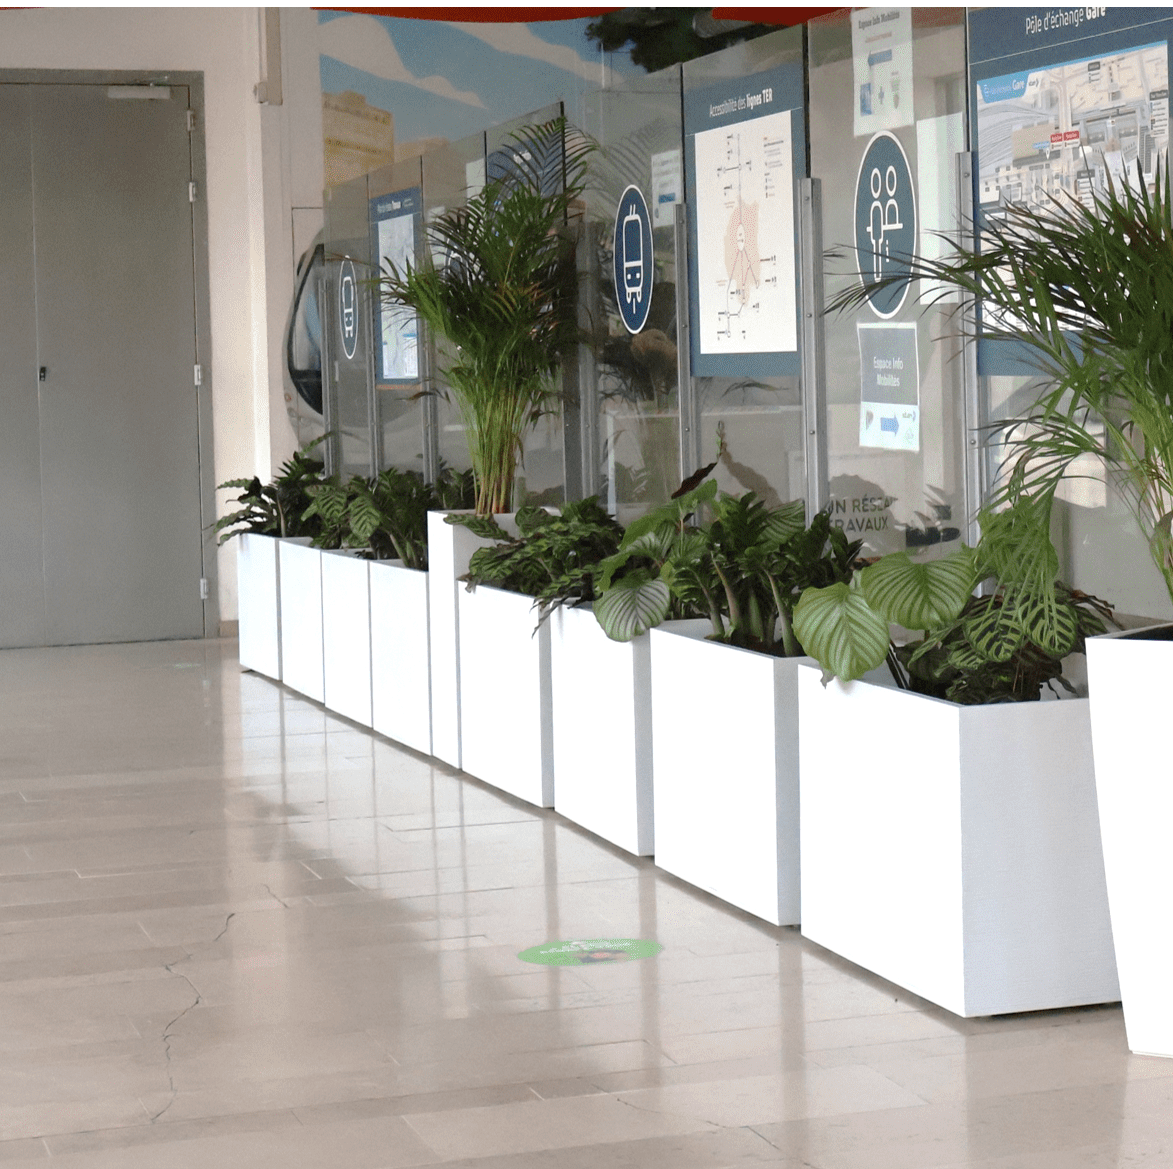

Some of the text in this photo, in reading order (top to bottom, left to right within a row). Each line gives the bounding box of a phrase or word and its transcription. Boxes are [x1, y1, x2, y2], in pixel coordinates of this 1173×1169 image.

[1025, 7, 1106, 35] Pôle d'échange Gare
[738, 95, 746, 110] des
[746, 93, 762, 110] lignes
[762, 88, 773, 103] TER
[873, 356, 904, 370] Espace Info
[829, 516, 888, 532] RAVAUX
